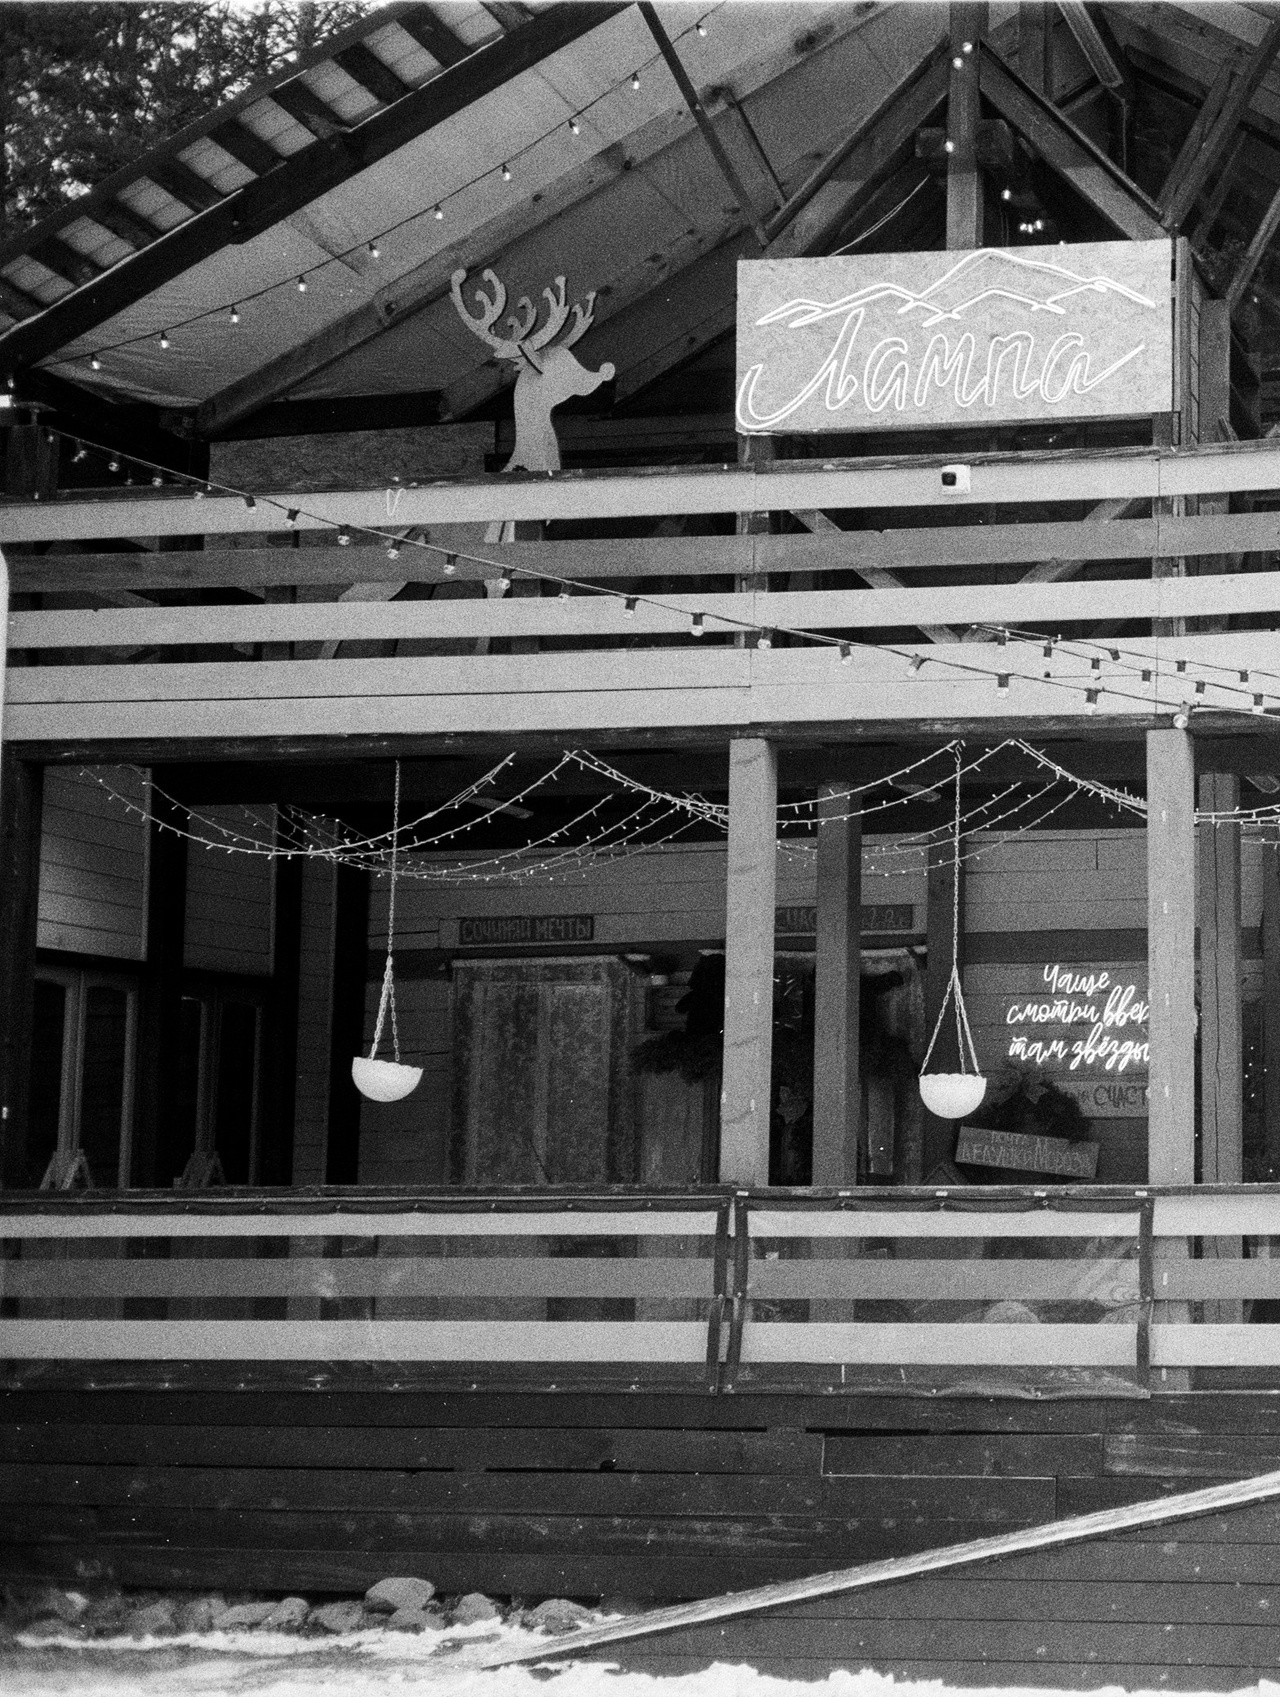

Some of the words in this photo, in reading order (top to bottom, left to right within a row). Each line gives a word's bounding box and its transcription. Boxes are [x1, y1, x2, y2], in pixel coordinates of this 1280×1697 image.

[736, 306, 1145, 431] Лампа
[535, 917, 592, 940] МЕЧТЫ
[1044, 964, 1110, 997] Чаще
[1006, 999, 1100, 1025] смотри
[1103, 984, 1149, 1027] ввер
[1008, 1036, 1068, 1064] там
